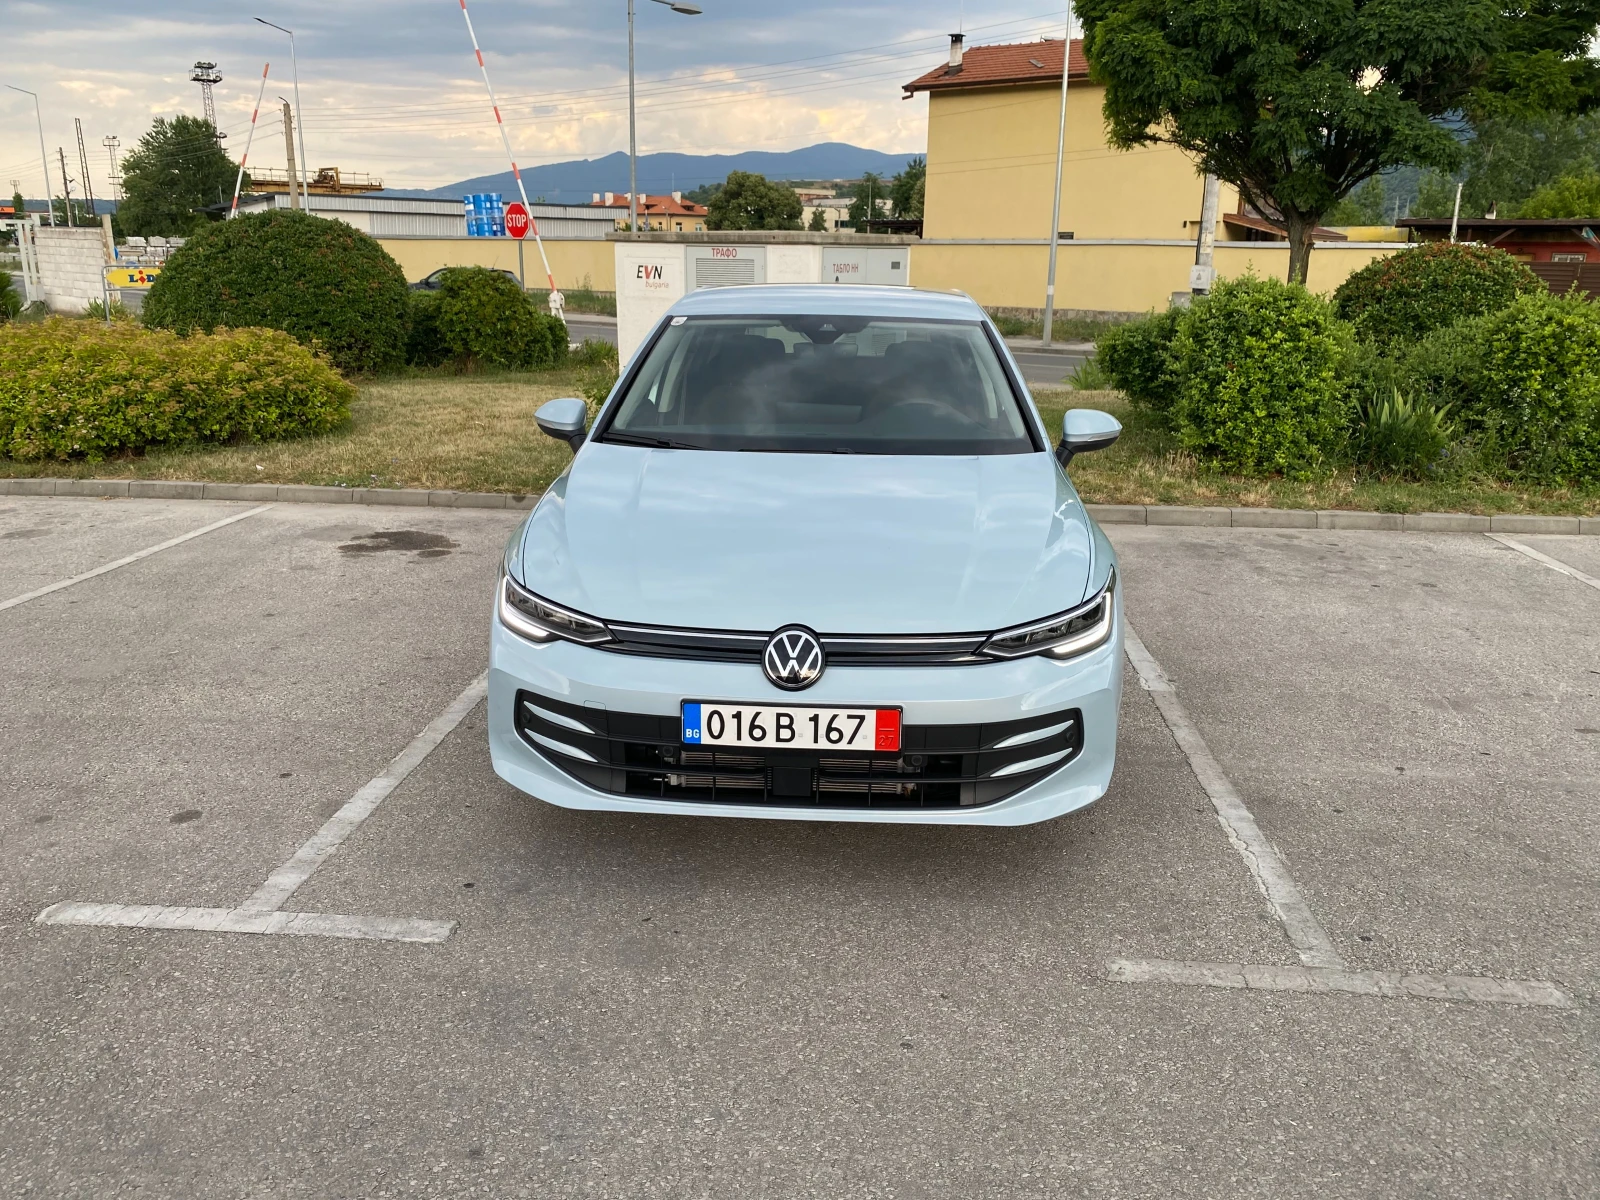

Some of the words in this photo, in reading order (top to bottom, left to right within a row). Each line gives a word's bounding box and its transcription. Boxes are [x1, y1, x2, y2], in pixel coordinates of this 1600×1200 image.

[507, 214, 527, 227] STOP
[711, 247, 737, 258] ТРАФО
[636, 264, 663, 280] EVN
[685, 728, 700, 738] BG
